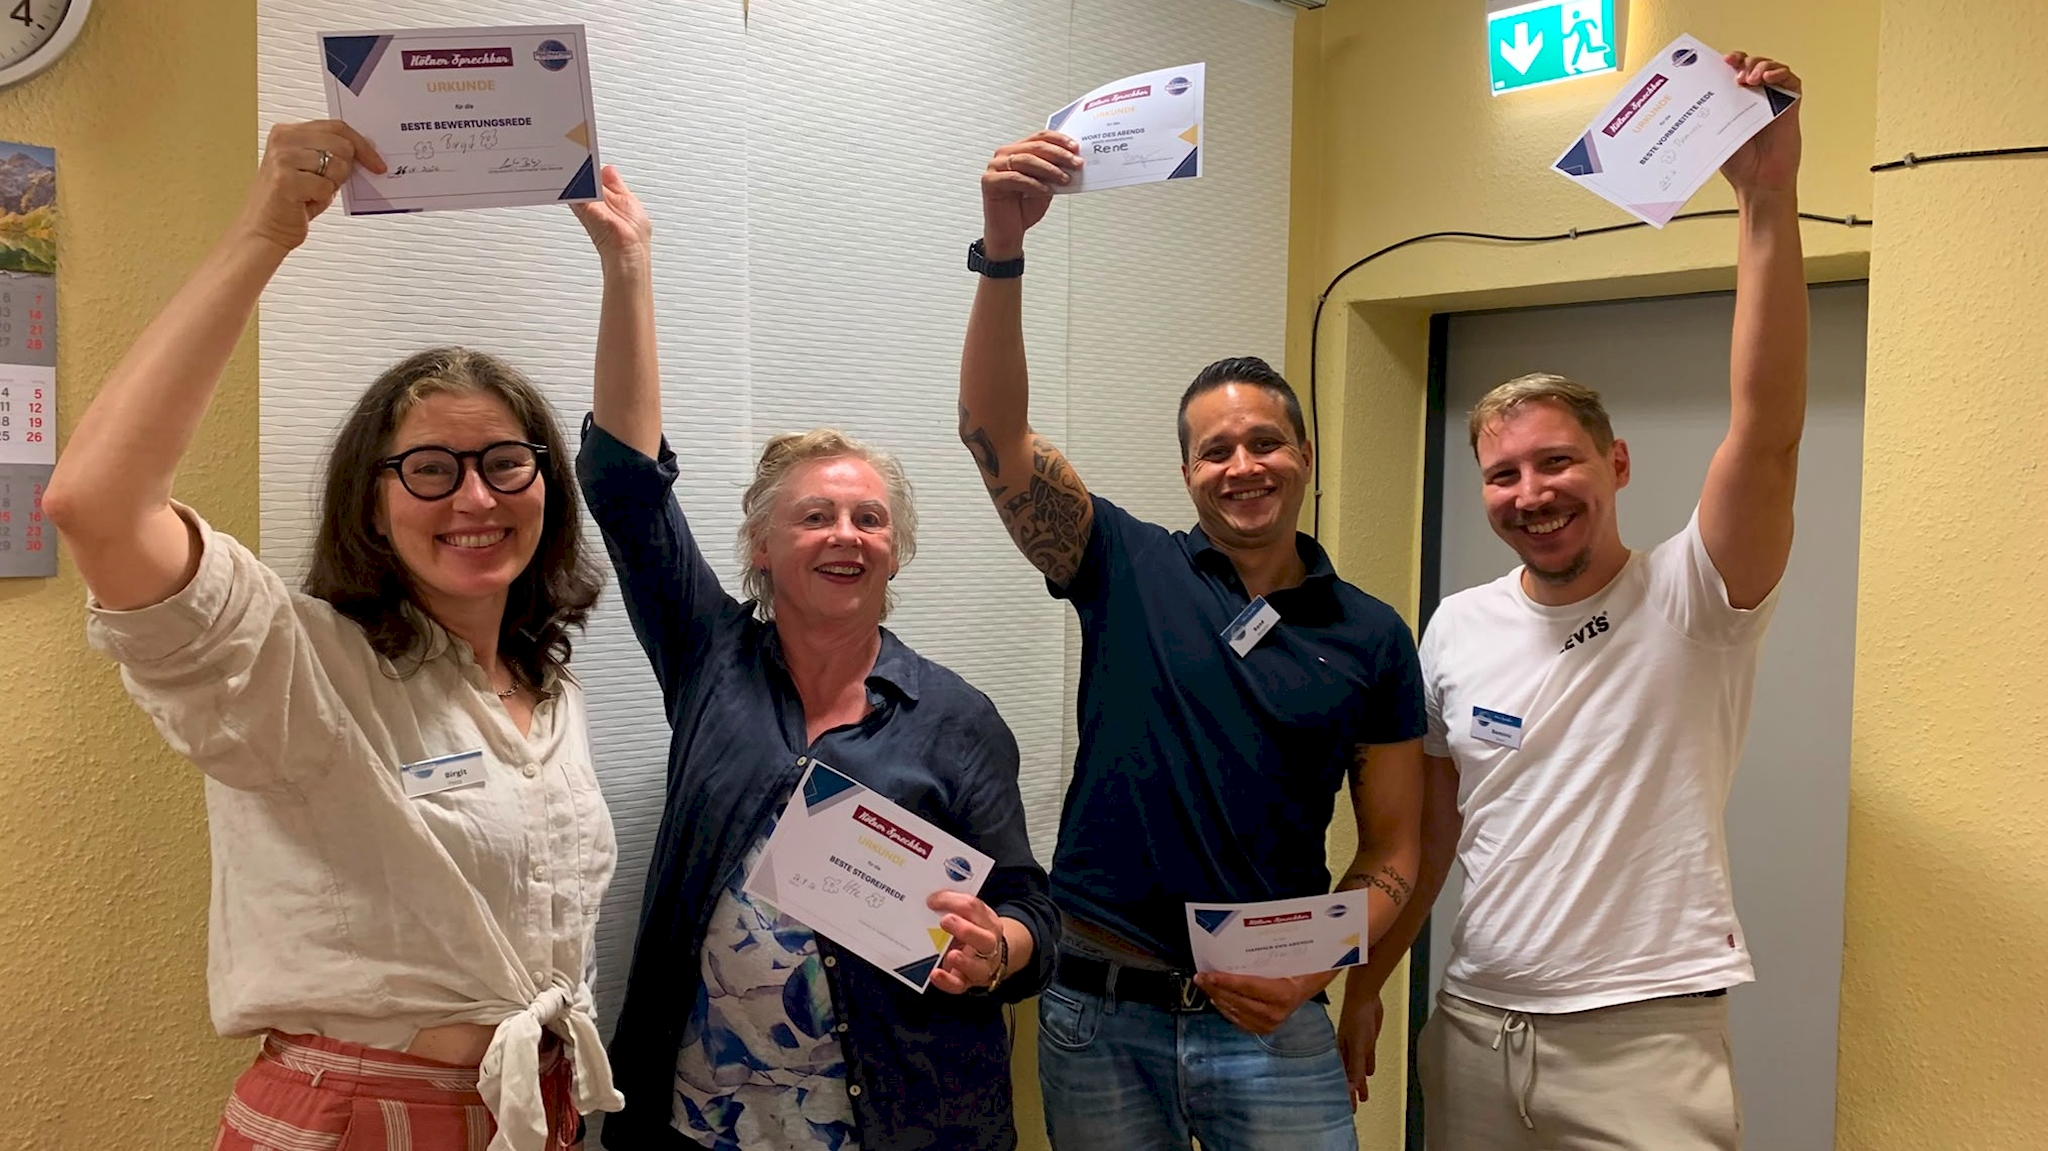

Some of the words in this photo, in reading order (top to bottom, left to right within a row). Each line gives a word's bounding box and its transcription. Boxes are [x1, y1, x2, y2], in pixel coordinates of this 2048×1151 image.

[10, 0, 33, 26] 4
[410, 54, 450, 67] Kölner
[451, 53, 509, 67] Sprechbar
[426, 80, 496, 93] URKUNDE
[1632, 94, 1672, 133] URKUNDE
[400, 121, 432, 131] BESTE
[434, 117, 532, 130] BEWERTUNGSREDE
[1639, 146, 1659, 165] BESTE
[1656, 103, 1699, 146] VORBEREITETE
[1696, 91, 1715, 106] REDE
[1081, 132, 1102, 141] WORT
[1102, 131, 1116, 139] DES
[1117, 128, 1145, 136] ABENDS
[1, 387, 9, 397] 4
[34, 389, 42, 399] 5
[28, 403, 42, 413] 12
[29, 417, 42, 428] 19
[26, 431, 42, 442] 26
[34, 484, 42, 495] 2
[444, 769, 467, 779] Birgit
[858, 811, 886, 833] Kölner
[886, 827, 927, 855] Sprechbar
[857, 835, 906, 867] URKUNDE
[829, 854, 853, 872] BESTE
[852, 868, 906, 902] STEGREIFREDE
